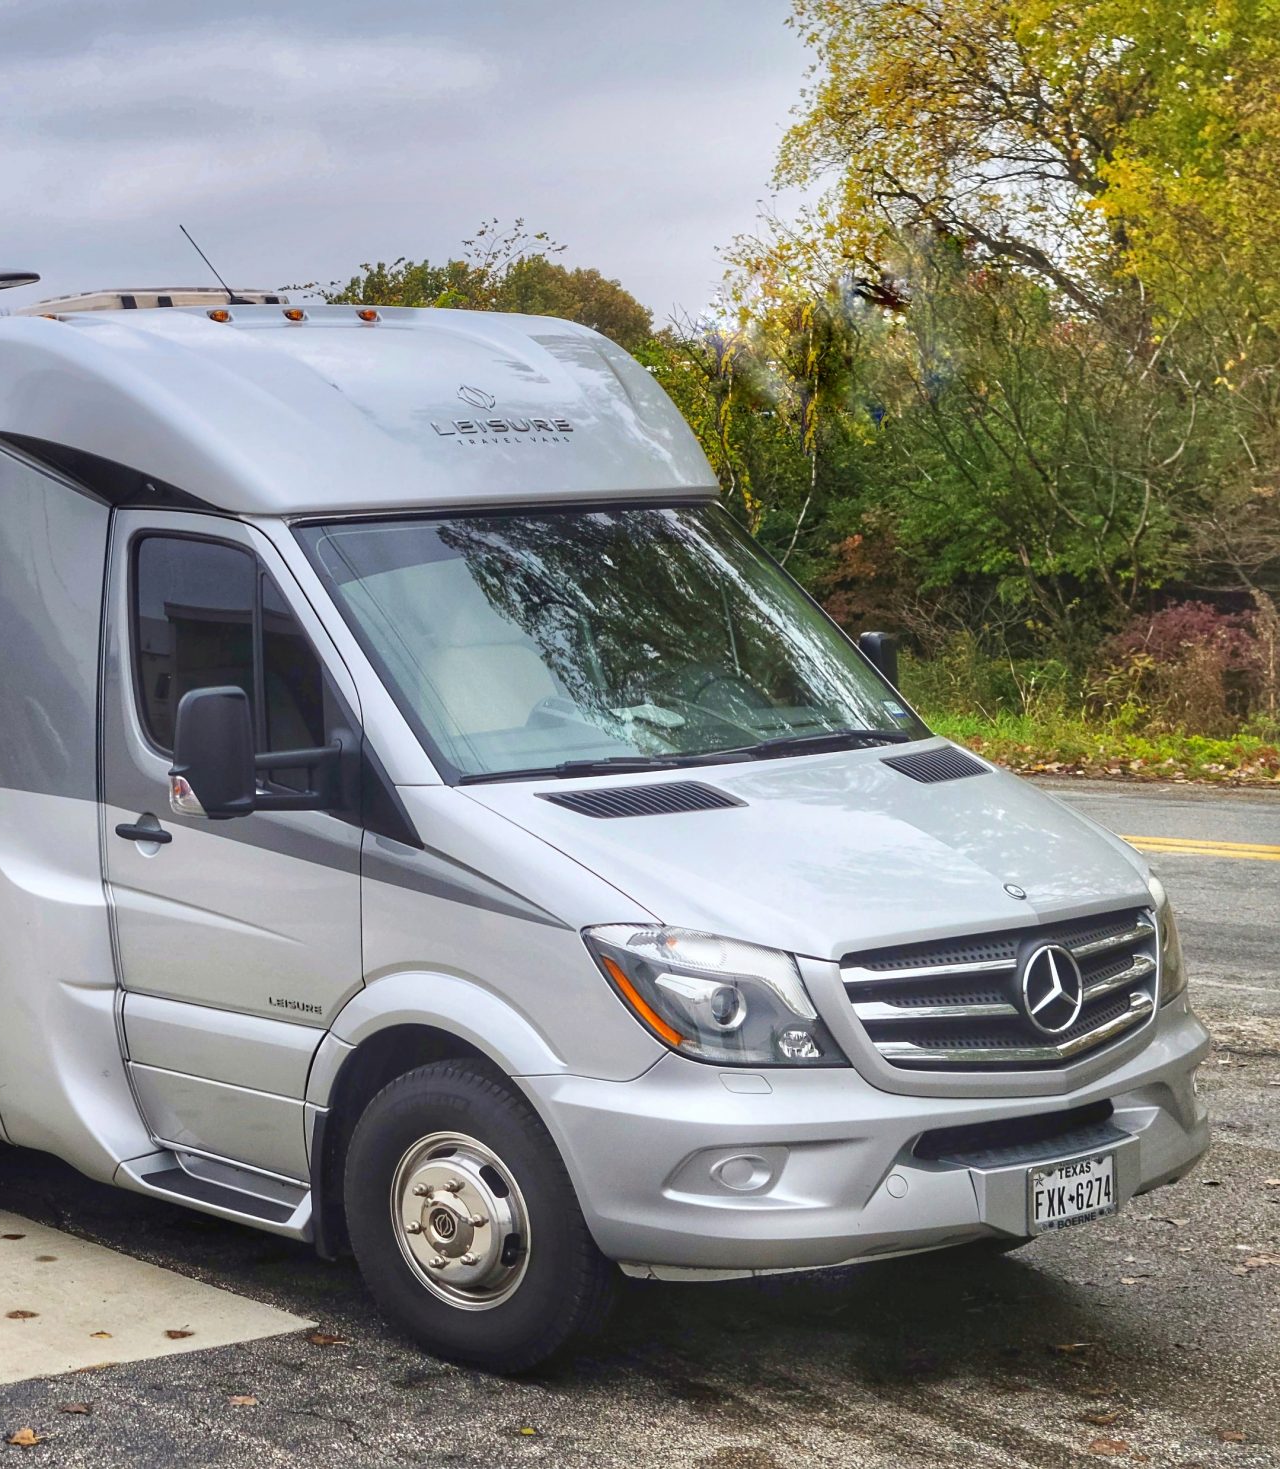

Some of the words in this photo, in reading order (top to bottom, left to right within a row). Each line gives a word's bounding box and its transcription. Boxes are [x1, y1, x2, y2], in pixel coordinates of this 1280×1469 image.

[430, 418, 574, 436] LEISURE
[457, 437, 522, 446] TRAVEL
[268, 996, 323, 1015] LEISURE
[1058, 1162, 1091, 1180] TEXAS
[1057, 1212, 1097, 1229] BOERNE
